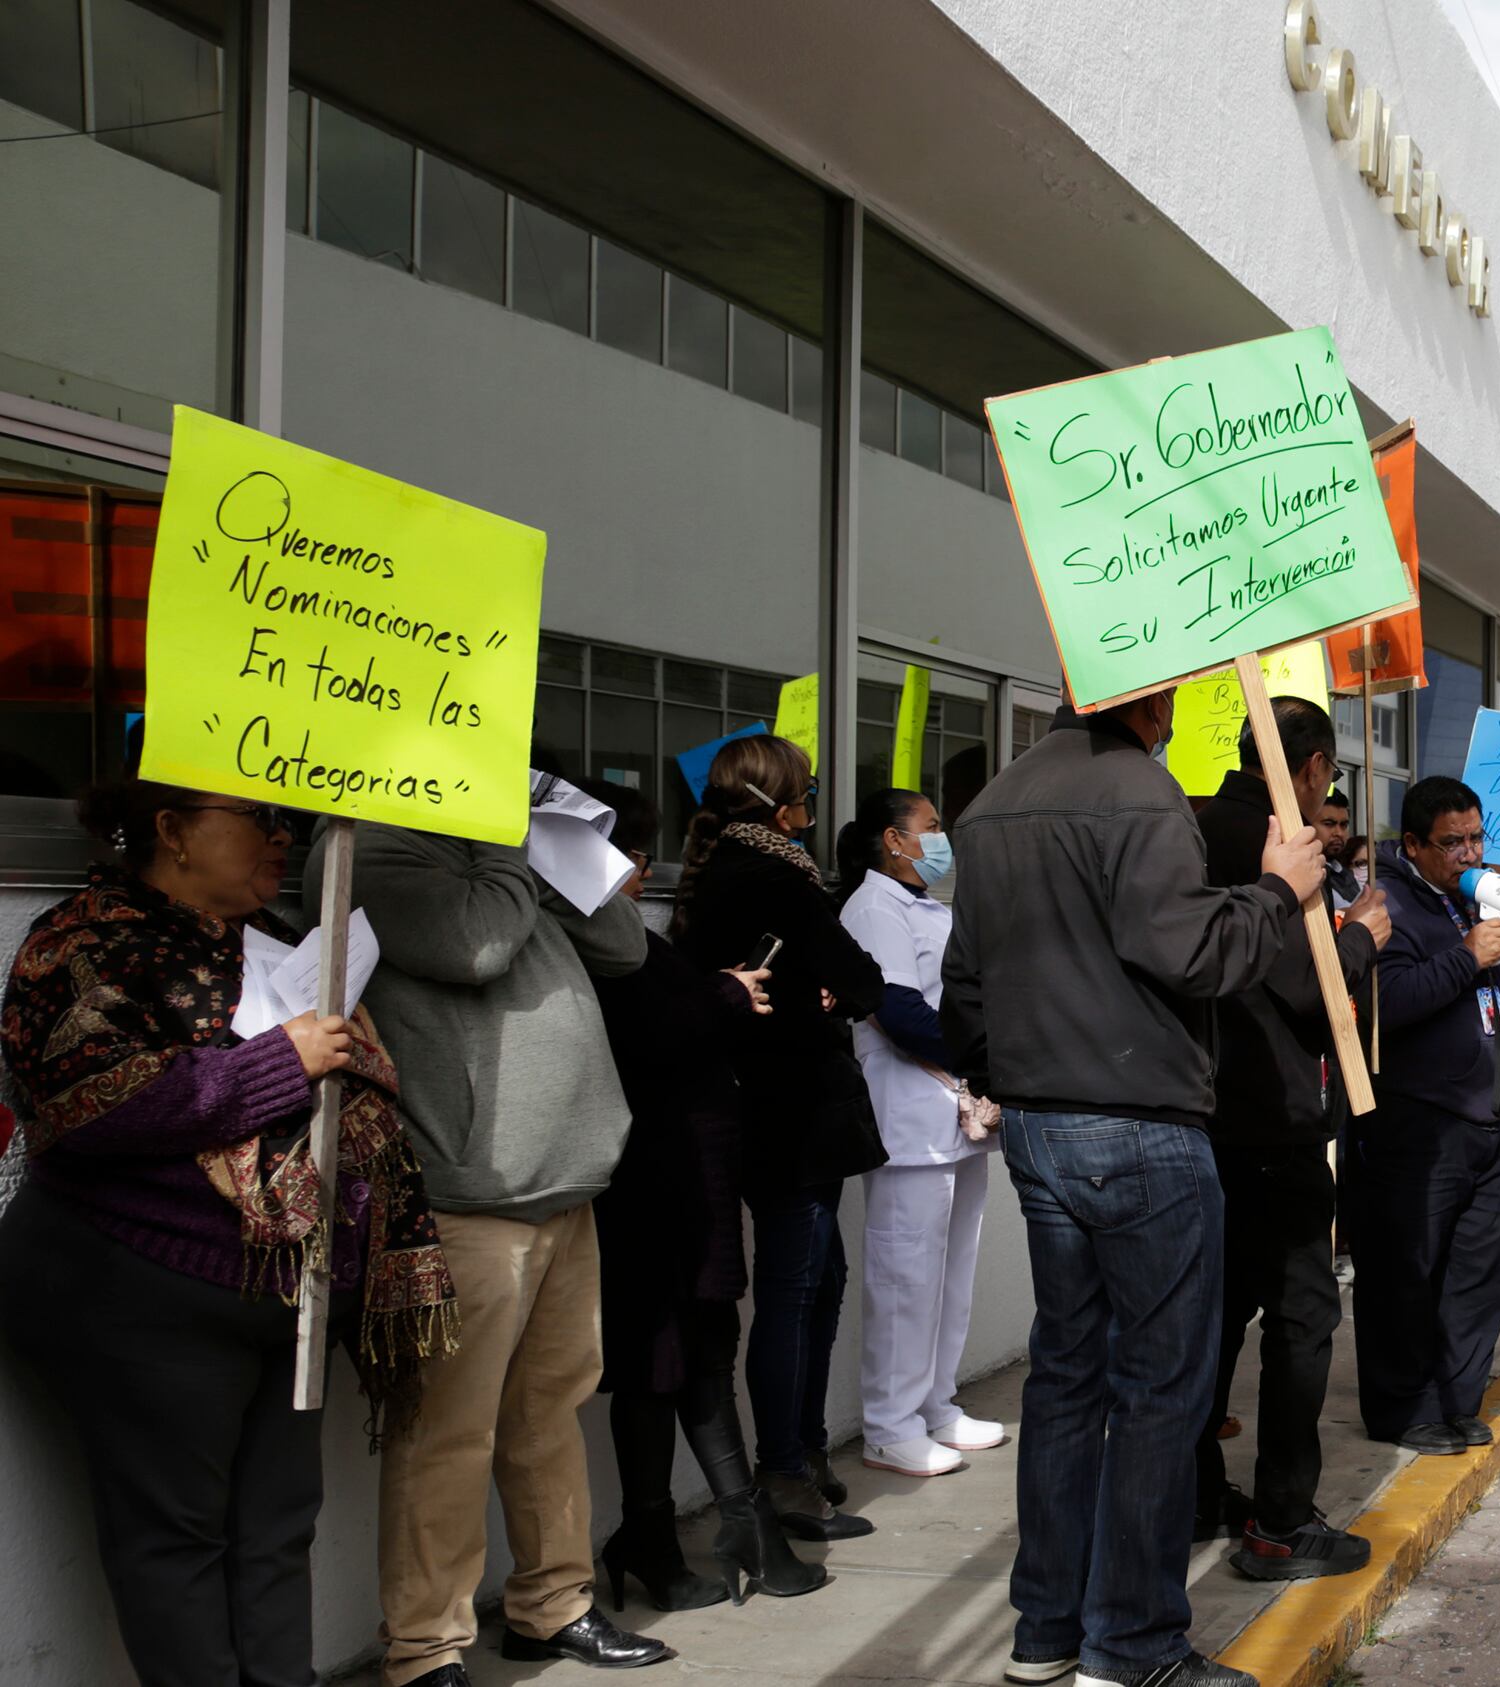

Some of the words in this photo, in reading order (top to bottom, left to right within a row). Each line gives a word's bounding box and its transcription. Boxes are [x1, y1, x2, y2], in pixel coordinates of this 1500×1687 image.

[1284, 0, 1490, 318] COMEDOR
[216, 471, 395, 578] Queremos
[1063, 506, 1249, 584] Solicitamos
[1262, 467, 1360, 528] Urgente
[239, 627, 285, 687] En
[307, 645, 401, 711] todas
[429, 671, 481, 727] las
